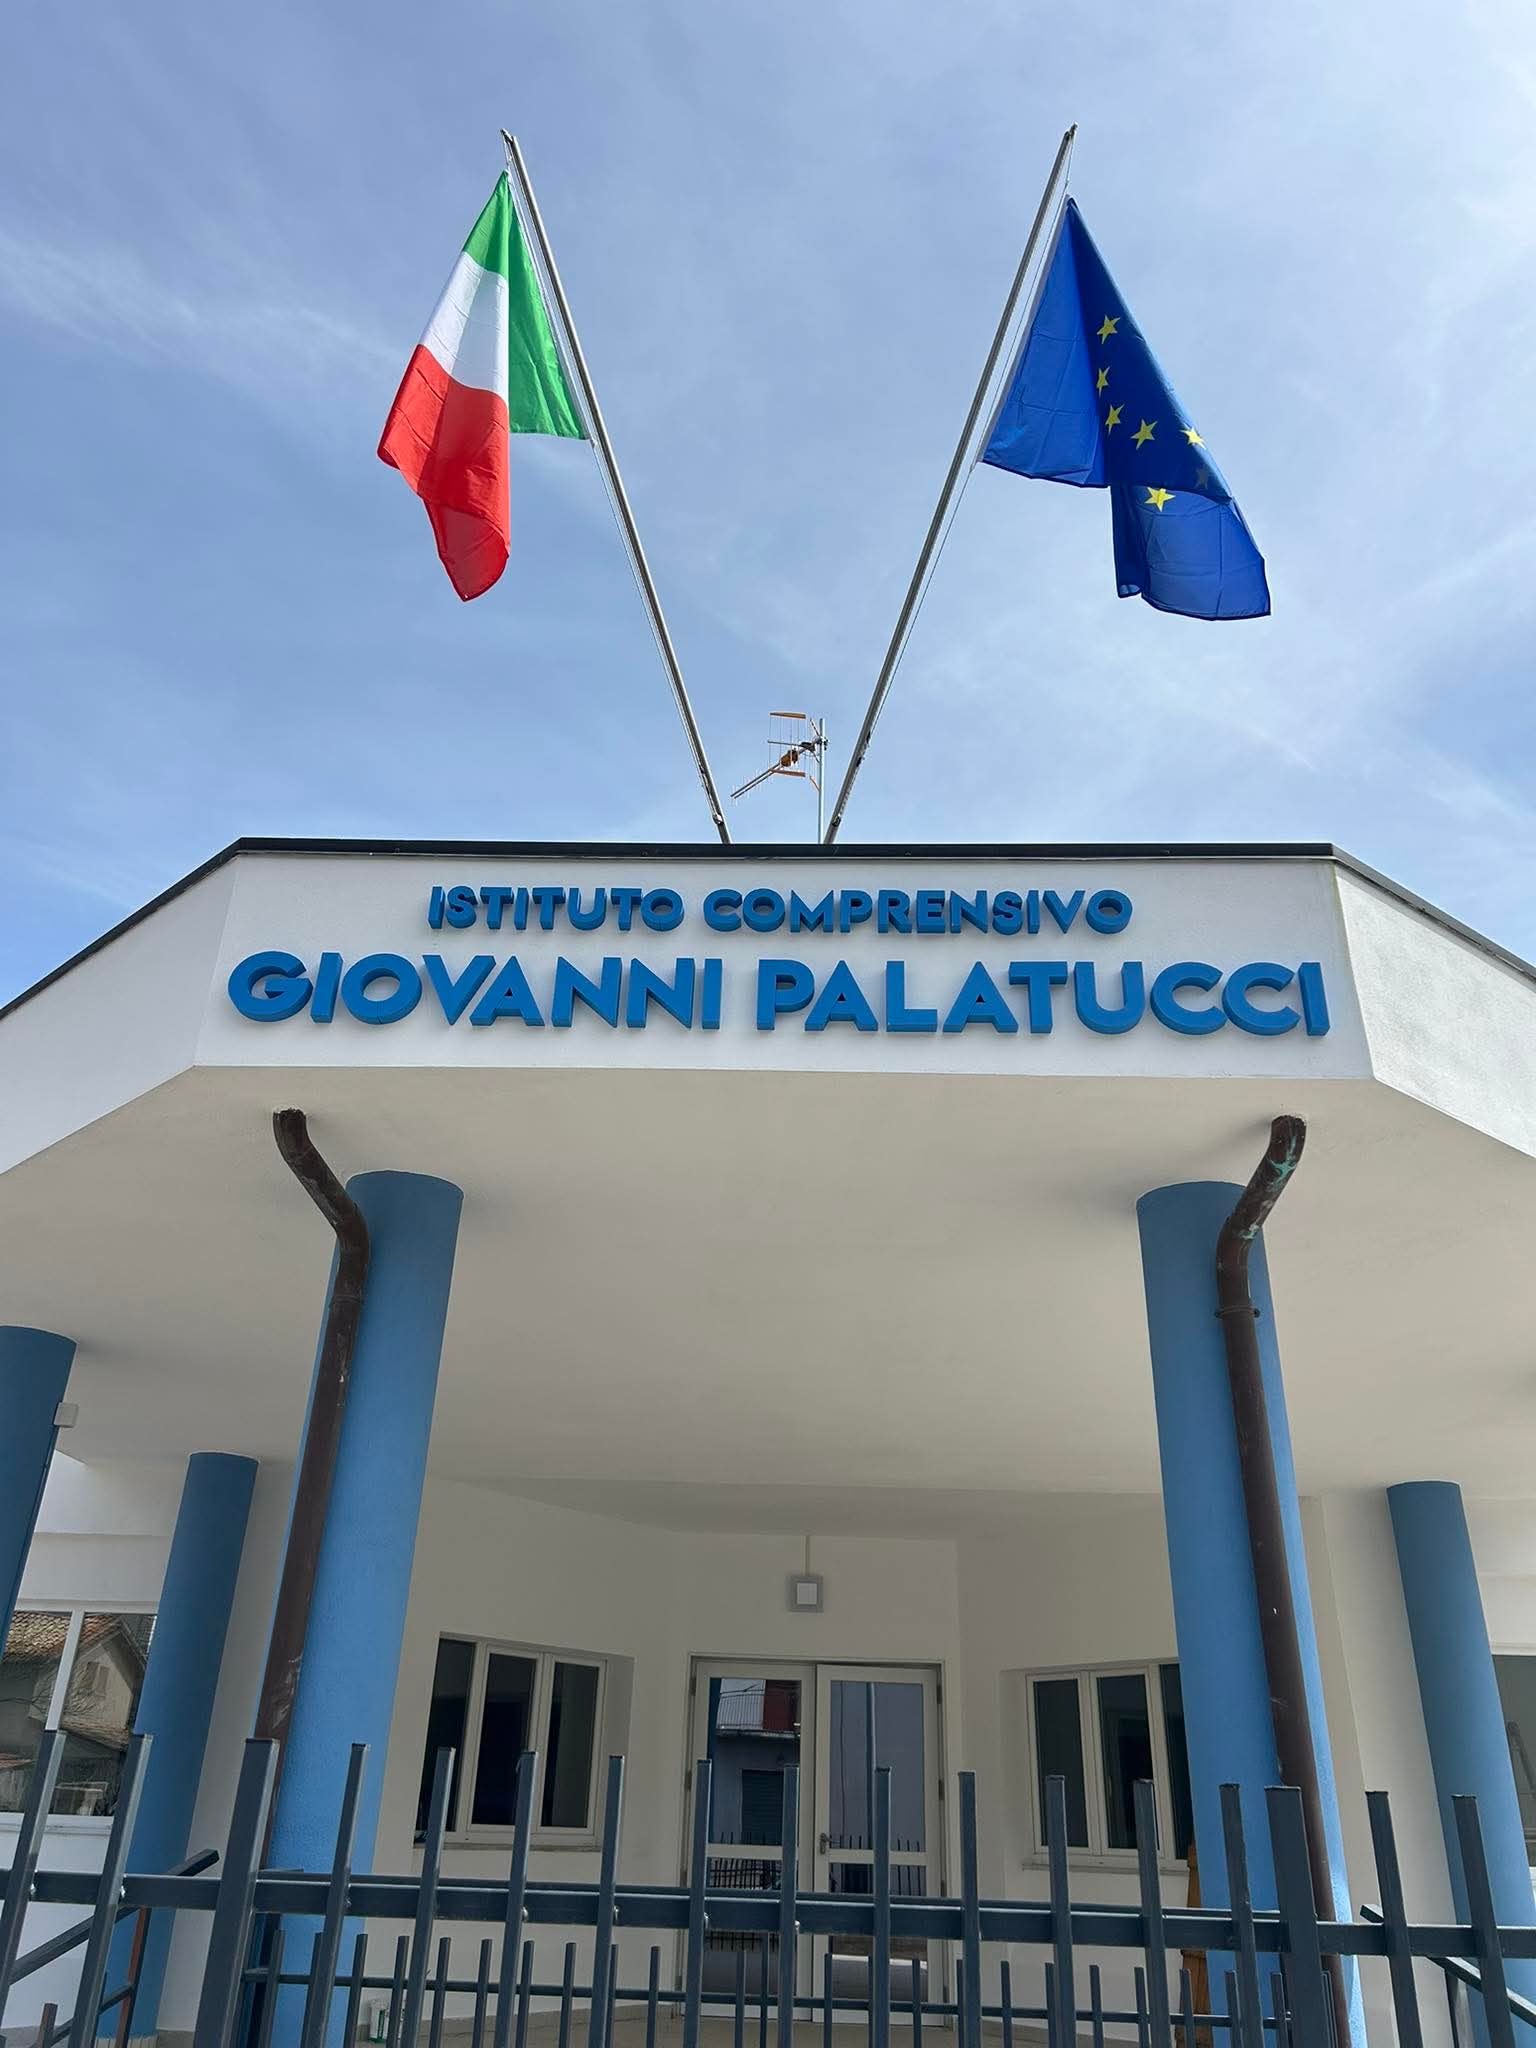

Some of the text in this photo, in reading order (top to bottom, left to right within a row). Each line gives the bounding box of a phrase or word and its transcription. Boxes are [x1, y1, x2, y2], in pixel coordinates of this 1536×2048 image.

[427, 885, 1133, 936] ISTITUTO COMPRENSIVO
[228, 950, 1331, 1037] GIOVANNI PALATUCCI
